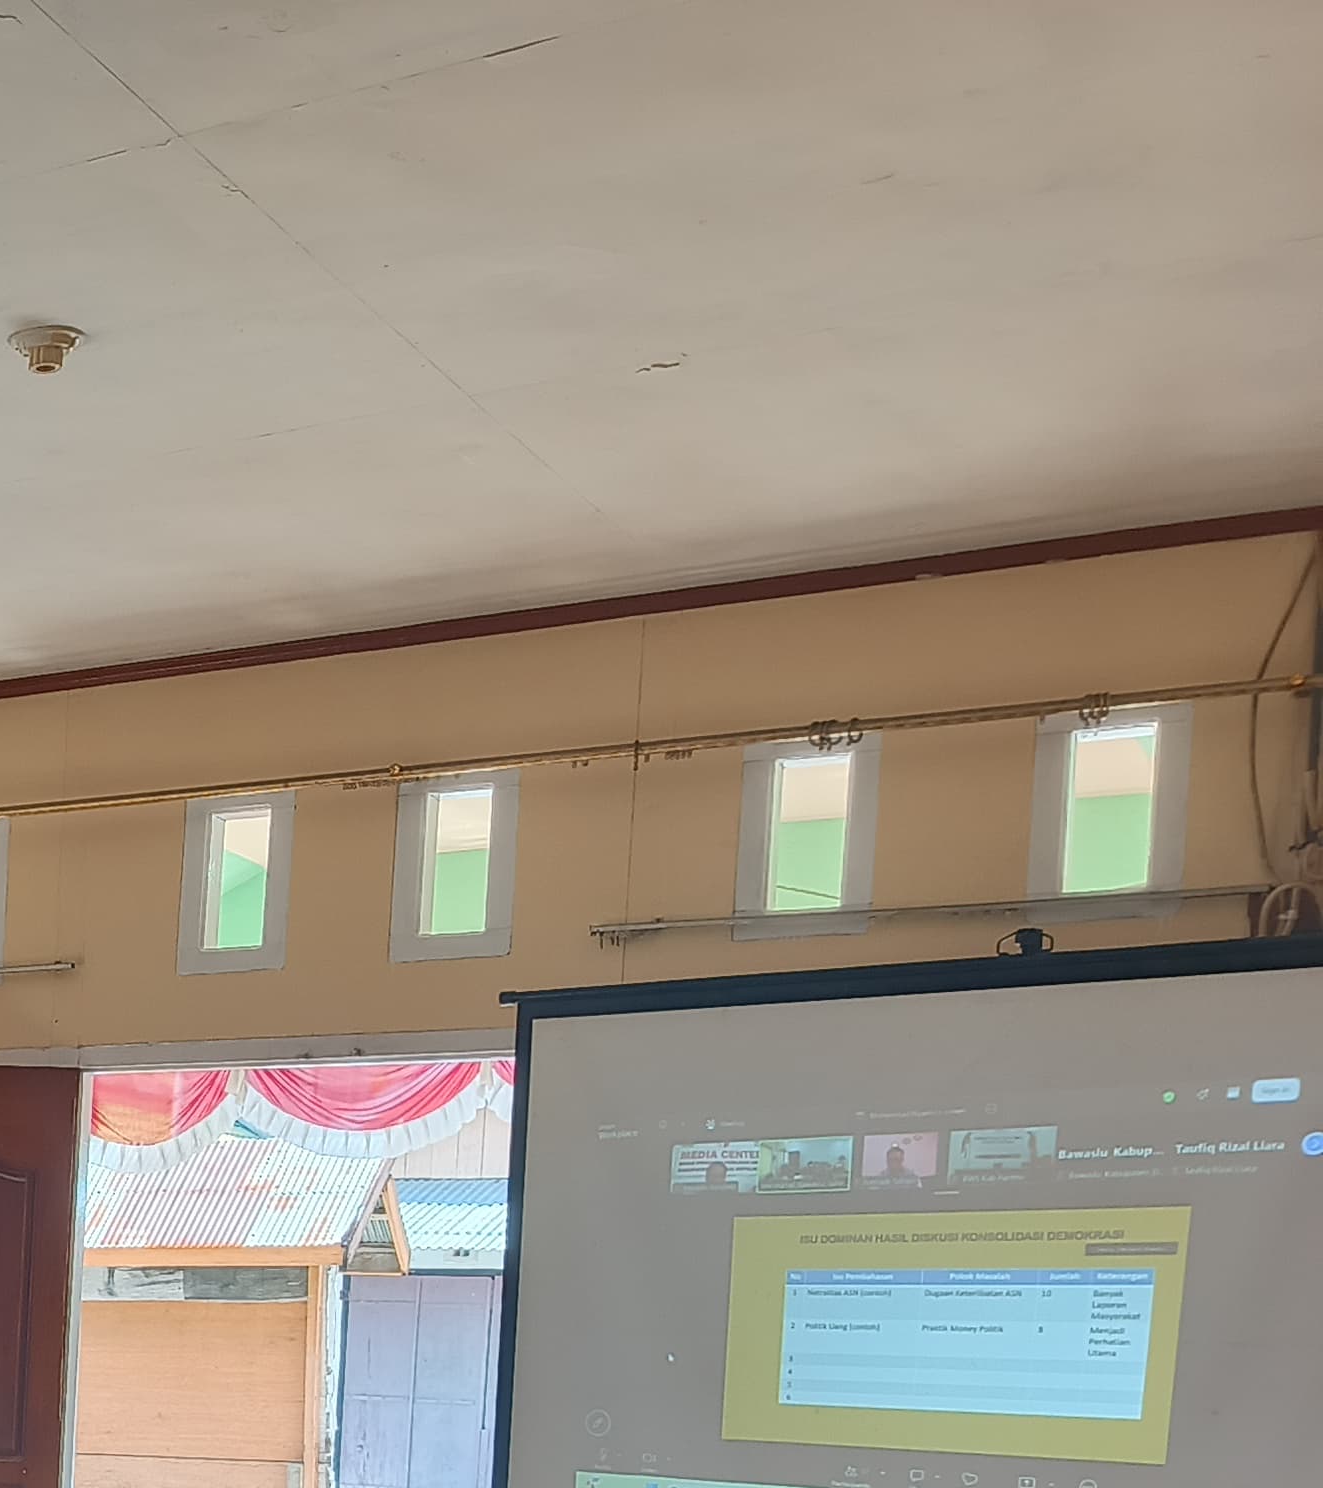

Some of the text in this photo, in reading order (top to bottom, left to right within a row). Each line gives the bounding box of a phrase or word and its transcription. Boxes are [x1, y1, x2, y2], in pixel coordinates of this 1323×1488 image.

[1175, 1140, 1286, 1155] Taufiq Rizal Liara
[680, 1151, 718, 1160] MEDIA
[1058, 1148, 1108, 1161] Bawaslu
[800, 1230, 1125, 1245] ISU DOMINAN HASIL DISKUSI KONSOLIDASI DEMOKRASI
[1087, 1349, 1117, 1357] Utama
